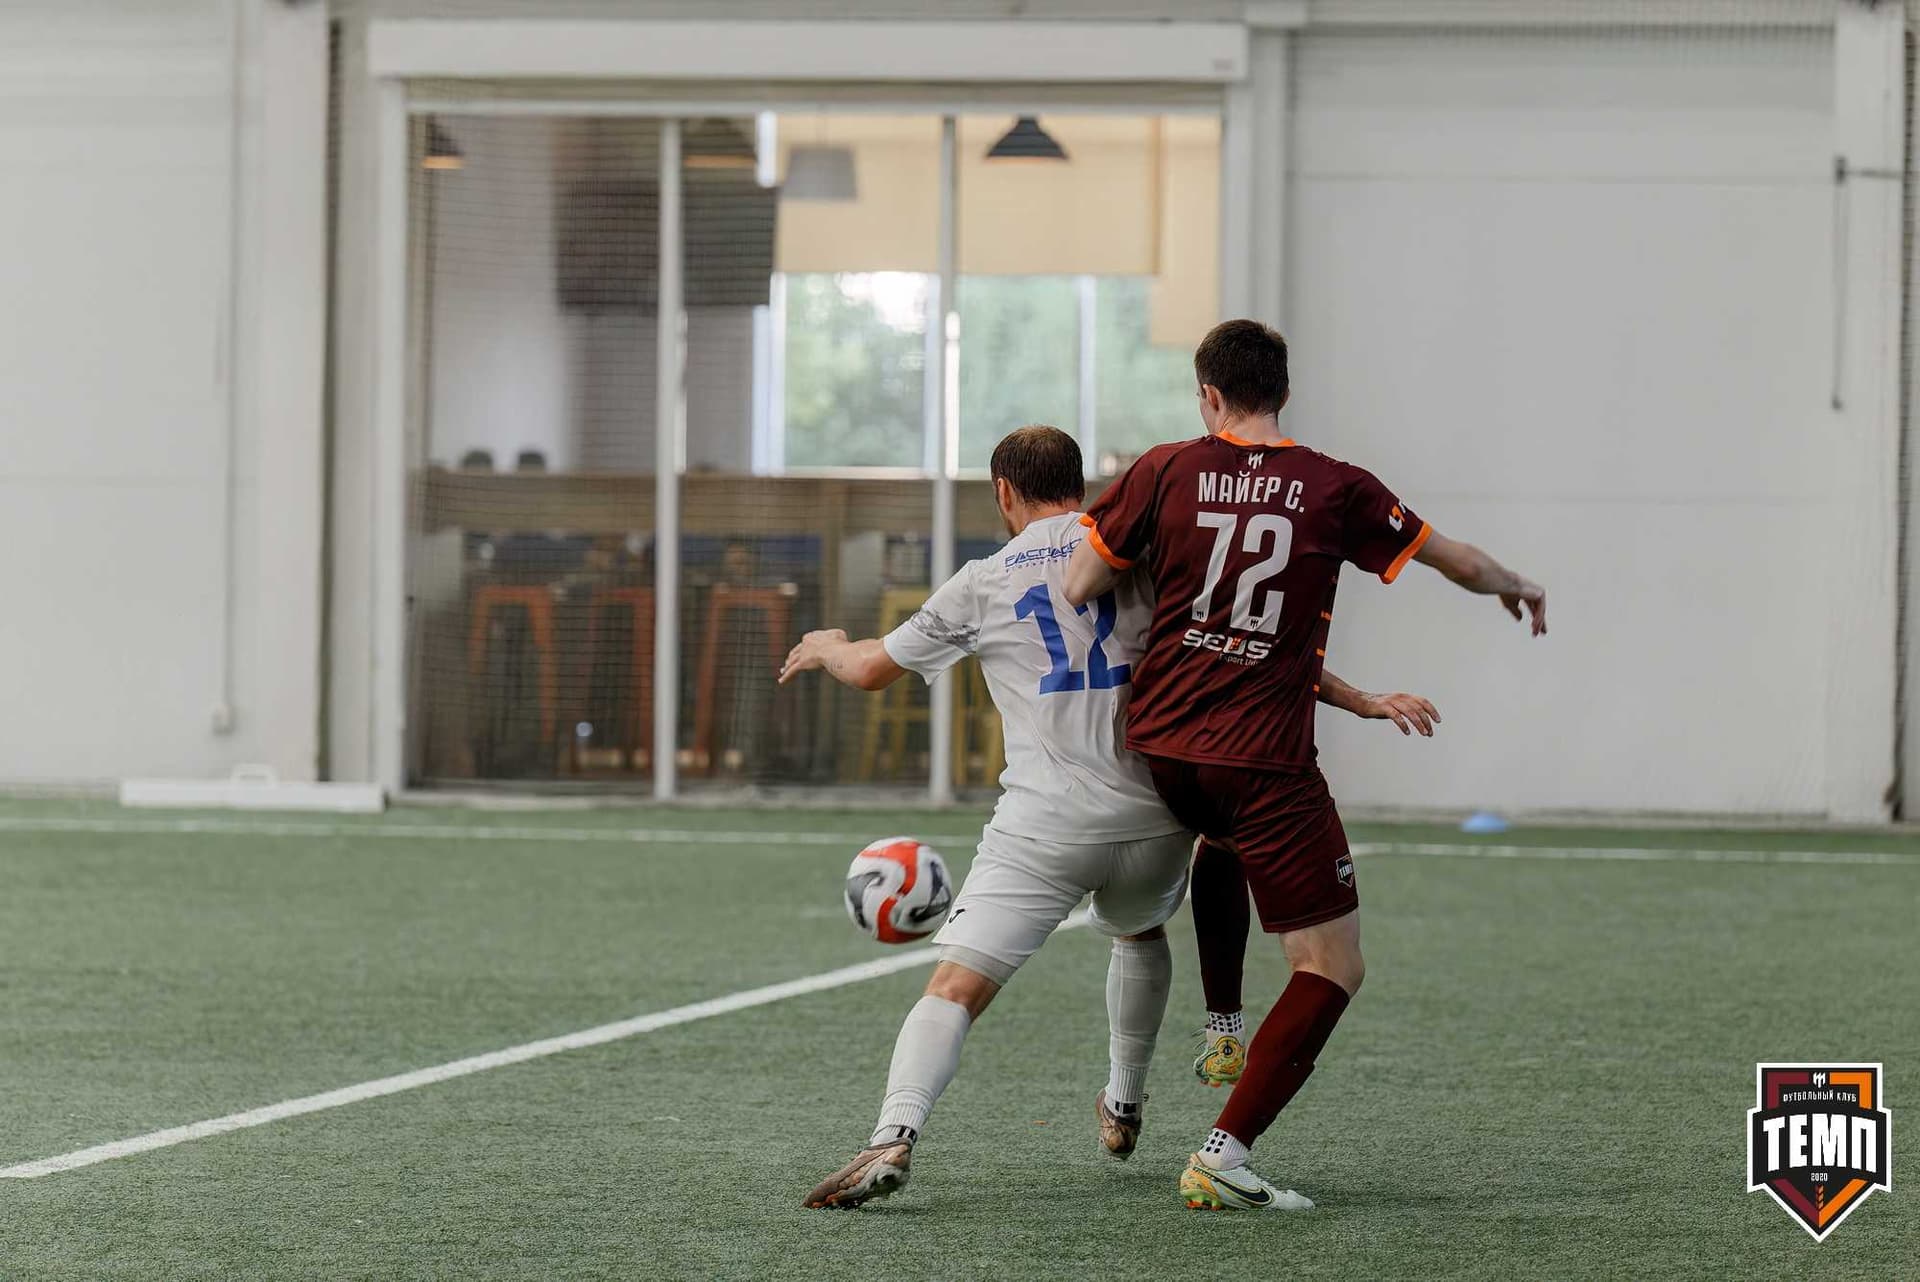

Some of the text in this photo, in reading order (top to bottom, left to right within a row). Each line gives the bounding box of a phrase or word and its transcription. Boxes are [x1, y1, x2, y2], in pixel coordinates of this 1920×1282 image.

[1198, 470, 1305, 513] МАЙЕР С.
[1191, 511, 1293, 635] 72
[1013, 583, 1132, 695] 12
